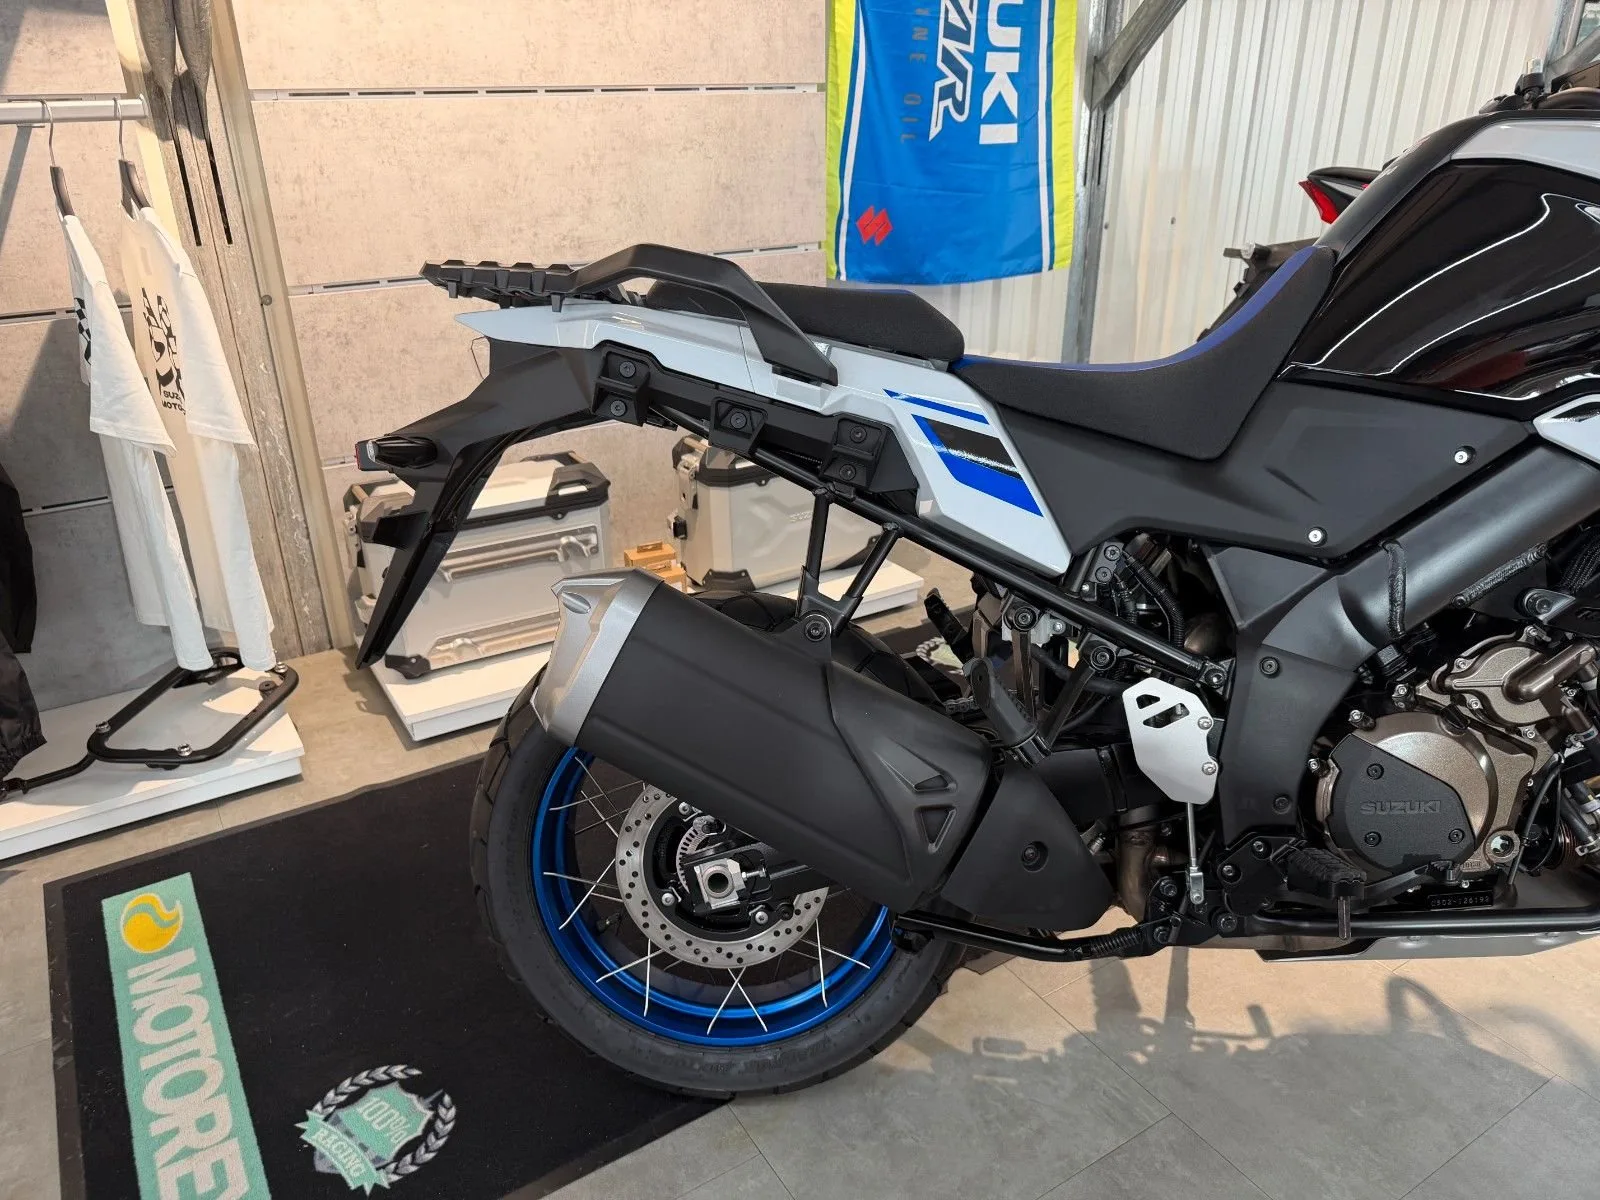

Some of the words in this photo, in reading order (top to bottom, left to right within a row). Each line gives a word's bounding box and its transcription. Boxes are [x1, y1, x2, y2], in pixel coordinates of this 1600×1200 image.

[900, 93, 922, 144] OIL
[1360, 800, 1442, 814] SUZUKI
[127, 948, 250, 1200] MOTORE
[355, 1096, 411, 1144] 100%
[311, 1127, 366, 1178] RACING
